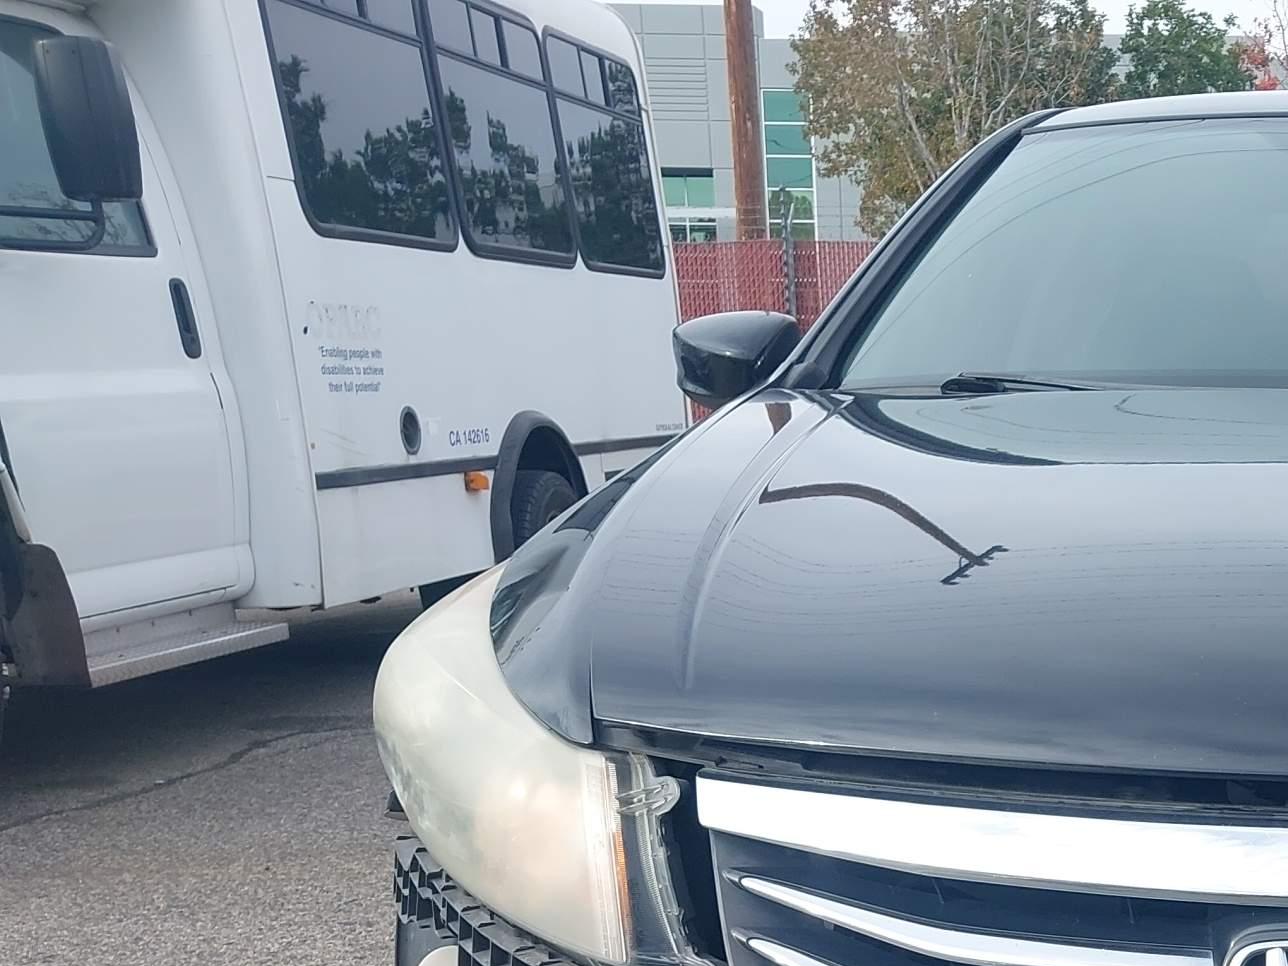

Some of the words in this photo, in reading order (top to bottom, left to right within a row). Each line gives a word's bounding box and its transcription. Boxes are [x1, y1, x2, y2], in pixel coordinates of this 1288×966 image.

[349, 348, 370, 361] people
[321, 364, 353, 375] disabilities
[353, 365, 361, 375] to
[362, 366, 384, 376] achieve
[328, 381, 343, 392] their
[343, 381, 354, 392] full
[449, 430, 462, 447] CA
